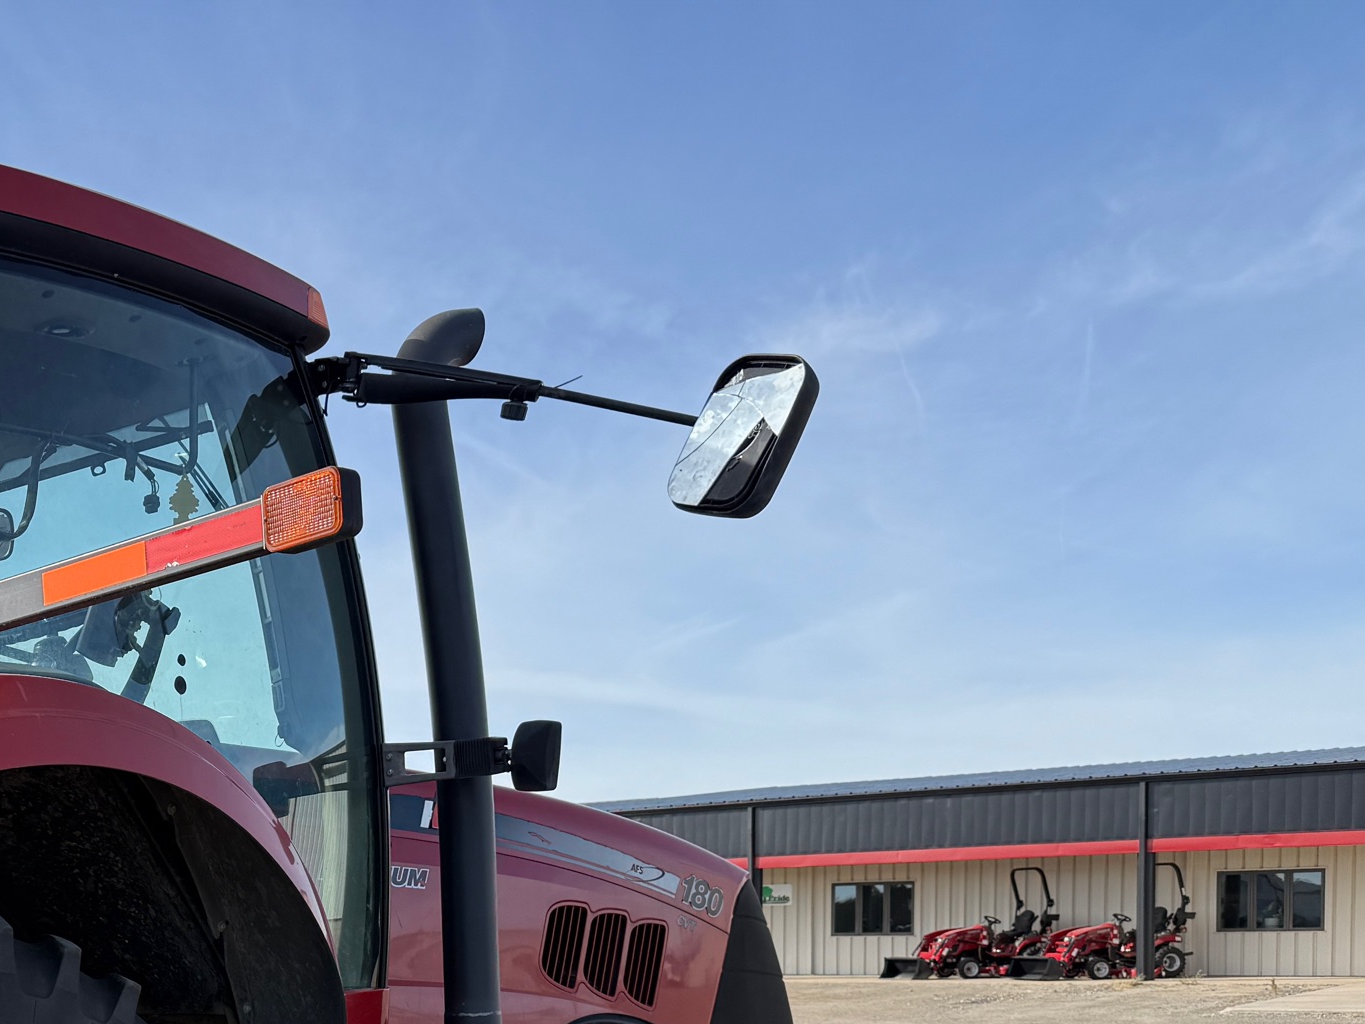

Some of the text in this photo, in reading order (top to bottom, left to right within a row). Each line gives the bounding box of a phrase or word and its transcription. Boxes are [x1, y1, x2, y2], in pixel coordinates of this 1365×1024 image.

[630, 863, 644, 875] AFS
[681, 875, 724, 918] 180
[768, 894, 790, 902] Pride
[677, 914, 697, 932] CVT
